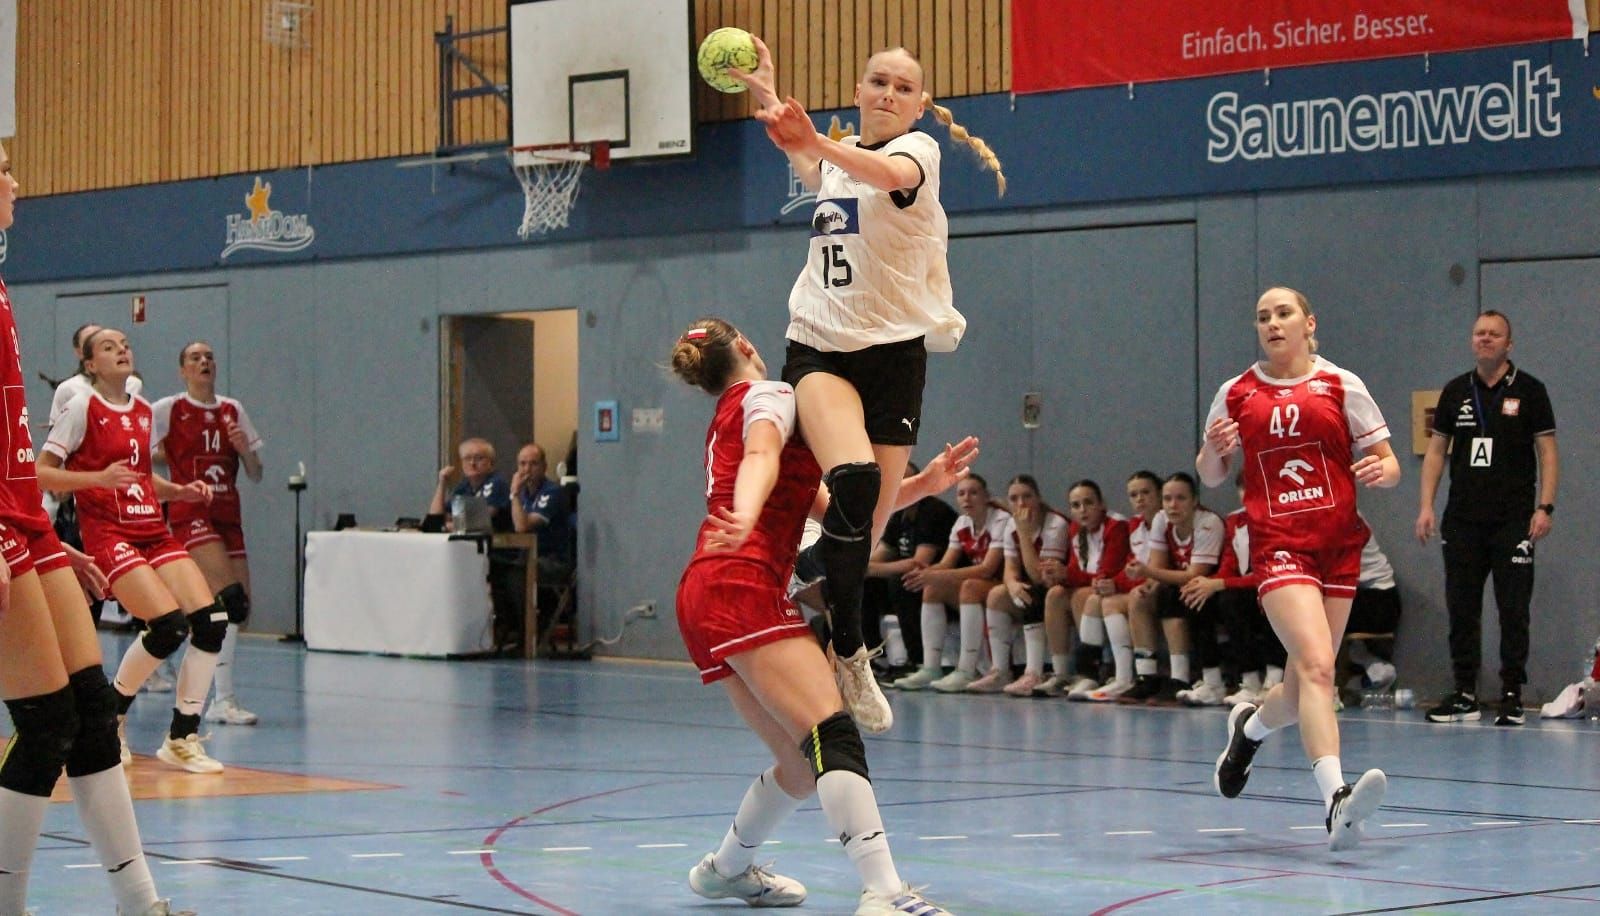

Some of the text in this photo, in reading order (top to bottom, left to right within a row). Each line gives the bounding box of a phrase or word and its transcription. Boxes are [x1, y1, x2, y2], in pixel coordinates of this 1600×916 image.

[1182, 13, 1434, 60] Einfach. Sicher. Besser.
[1207, 59, 1561, 163] Saunenwelt
[822, 244, 853, 289] 15
[1269, 403, 1301, 438] 42
[129, 438, 140, 466] 3
[202, 429, 221, 453] 14
[1473, 442, 1489, 464] A
[1278, 486, 1324, 504] ORLEN
[126, 504, 155, 515] ORLEN
[0, 538, 17, 552] LEN
